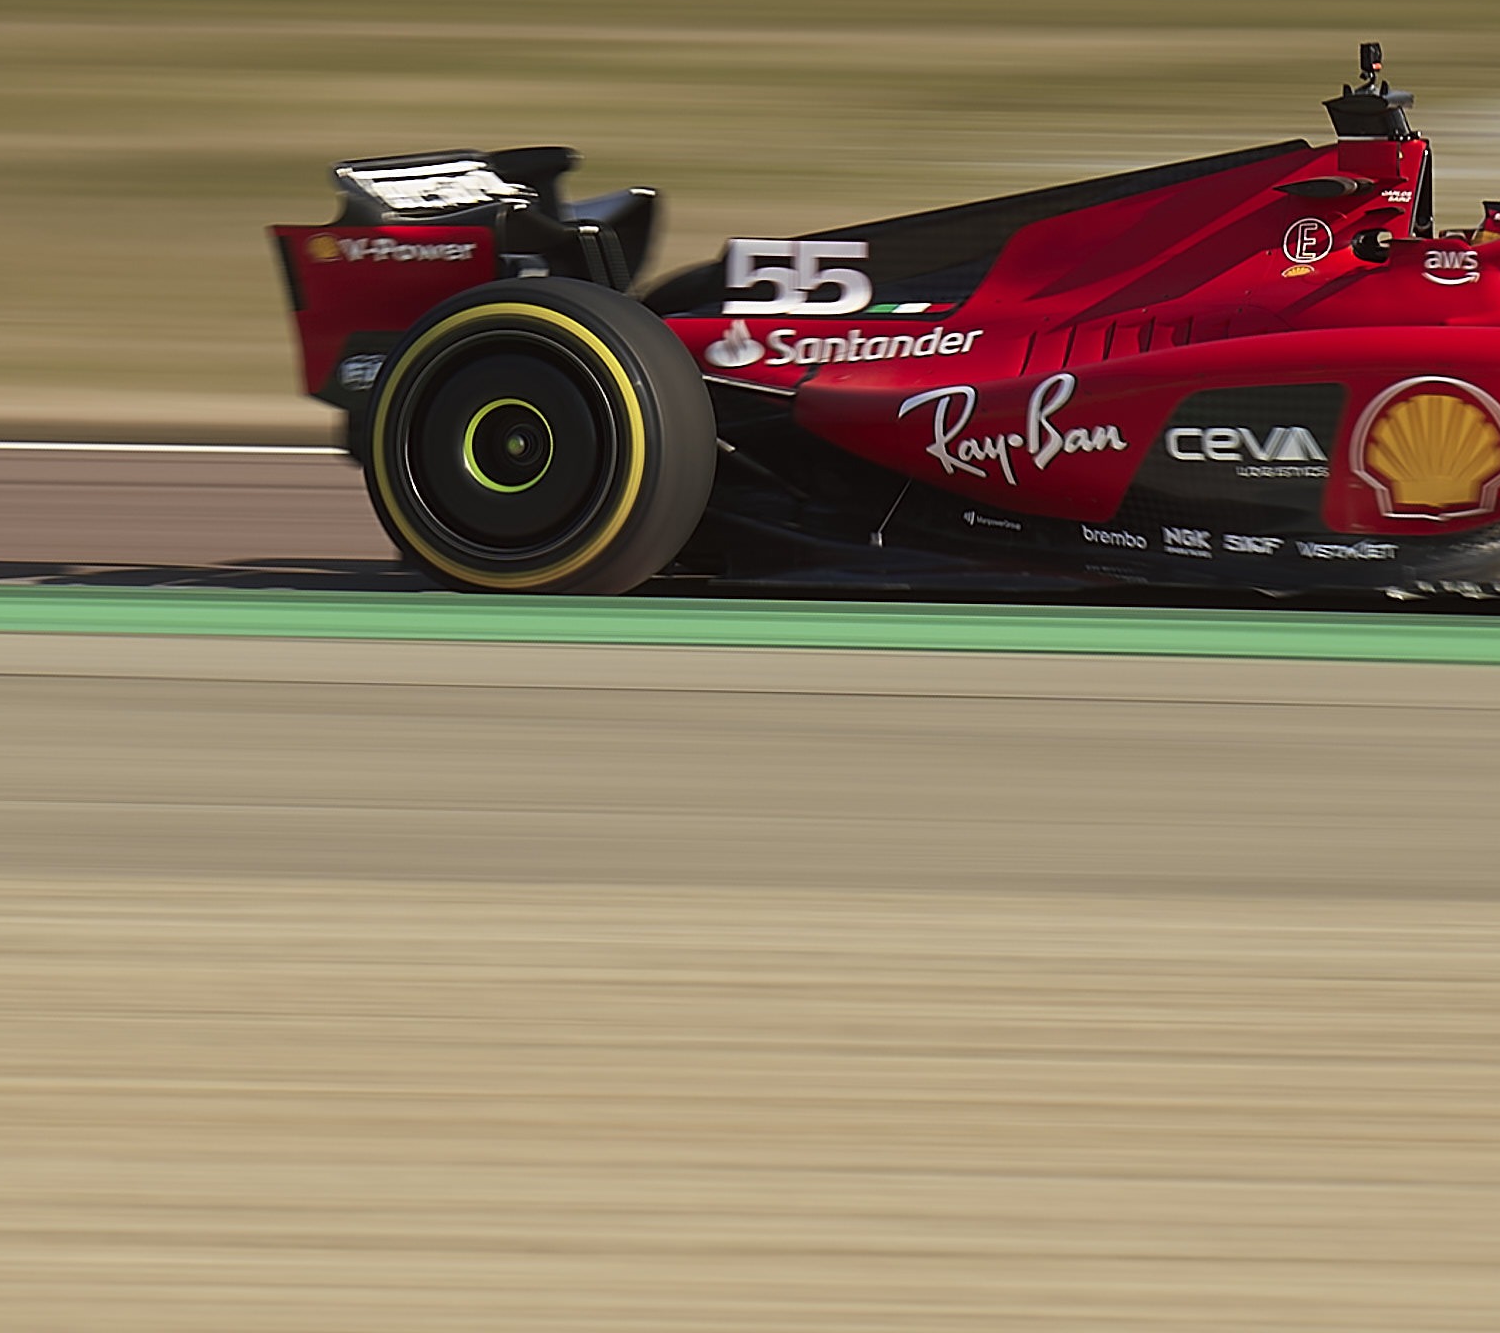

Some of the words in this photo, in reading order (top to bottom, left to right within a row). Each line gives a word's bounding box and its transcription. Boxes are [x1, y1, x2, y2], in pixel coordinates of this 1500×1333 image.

[1424, 250, 1480, 270] aws
[722, 238, 873, 315] 55
[764, 327, 984, 366] Santander
[1081, 523, 1148, 550] brembo
[1162, 526, 1213, 550] NGK
